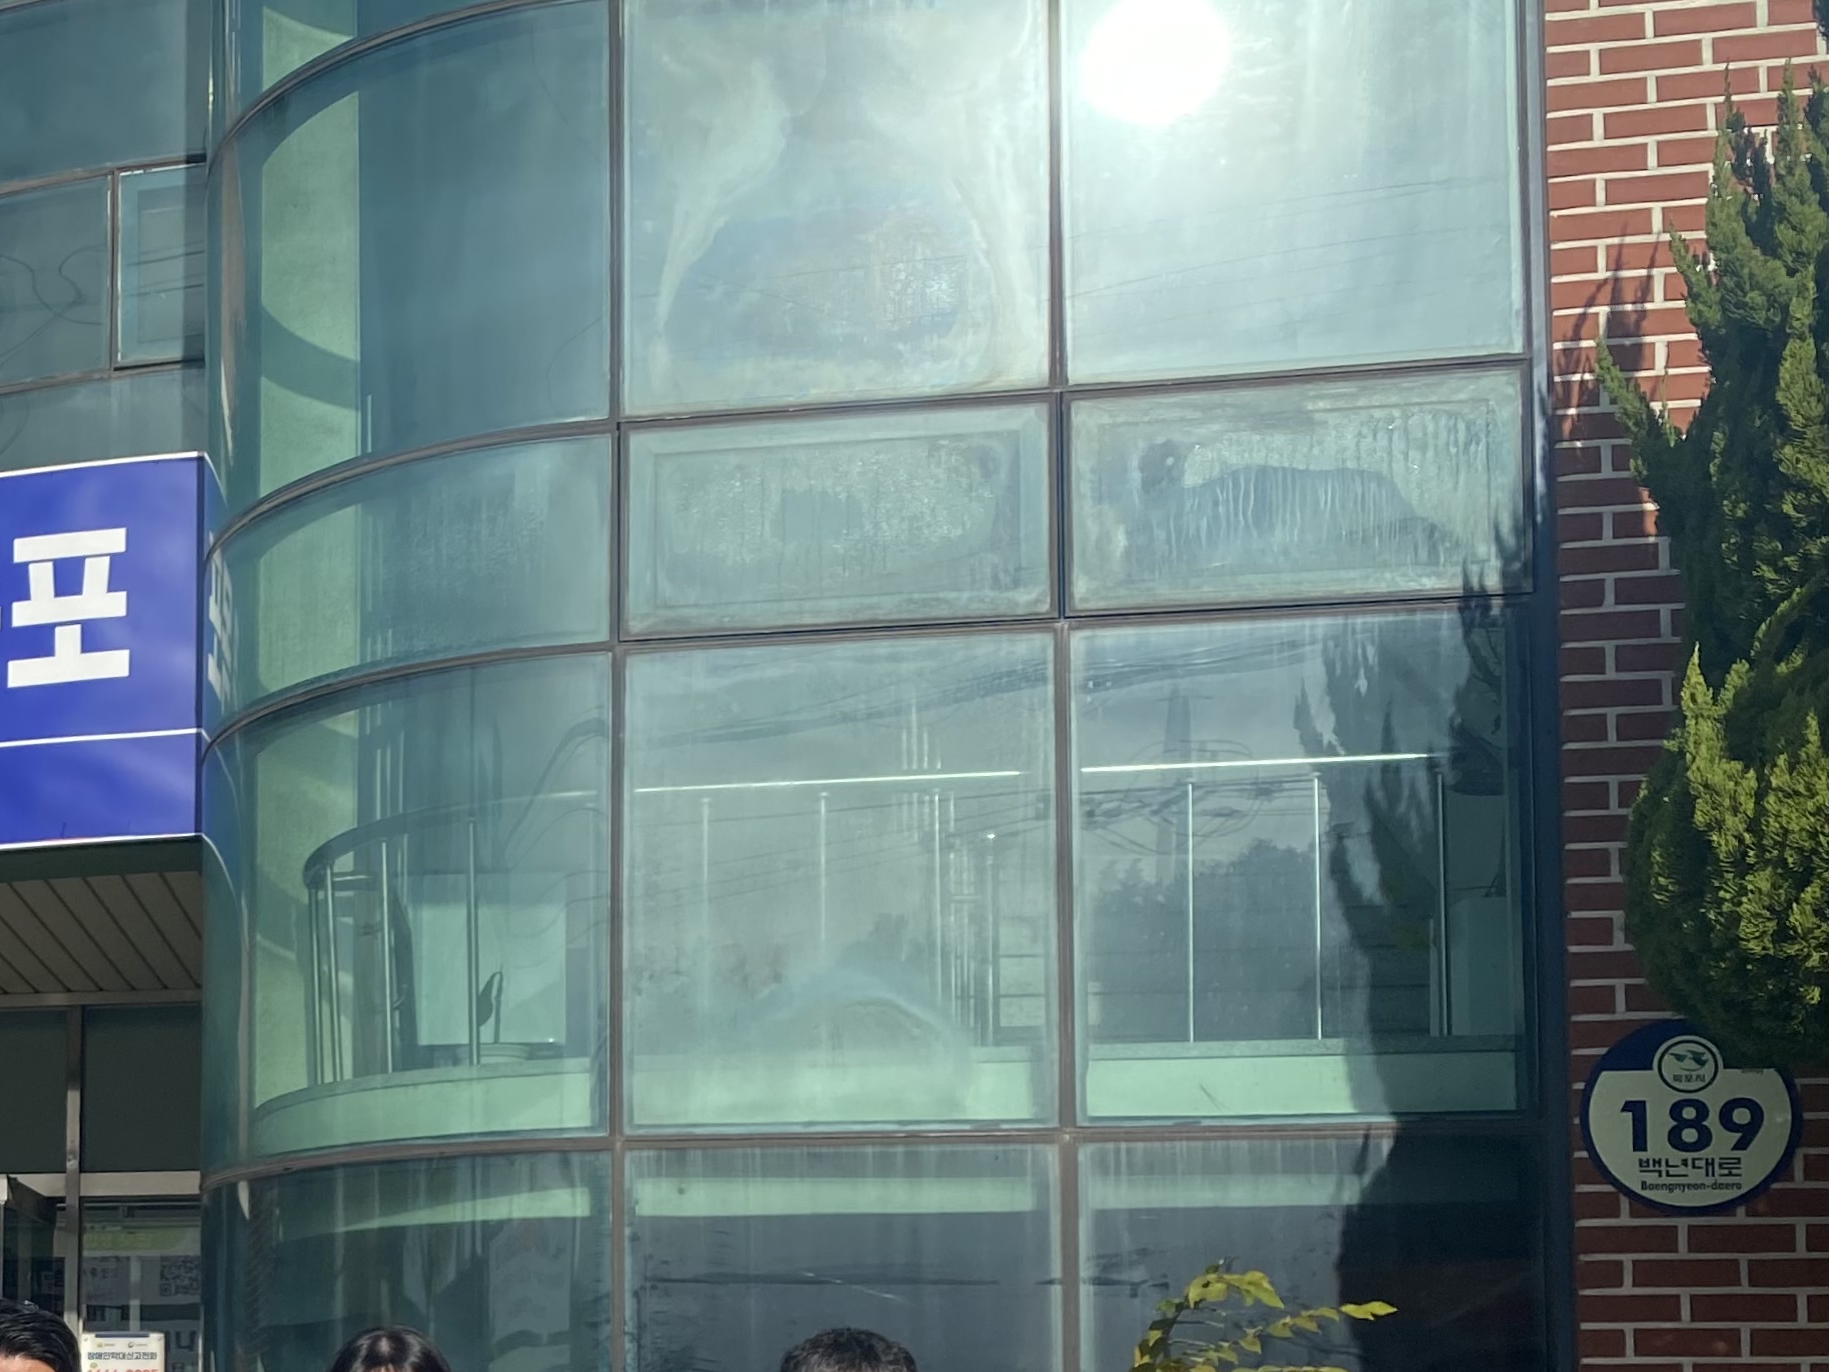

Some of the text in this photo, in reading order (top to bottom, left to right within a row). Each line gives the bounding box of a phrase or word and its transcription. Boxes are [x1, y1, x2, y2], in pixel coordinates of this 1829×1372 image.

[1620, 1097, 1764, 1153] 189
[1639, 1157, 1742, 1178] 백년대로
[1641, 1181, 1742, 1193] Baengnyeon-daero
